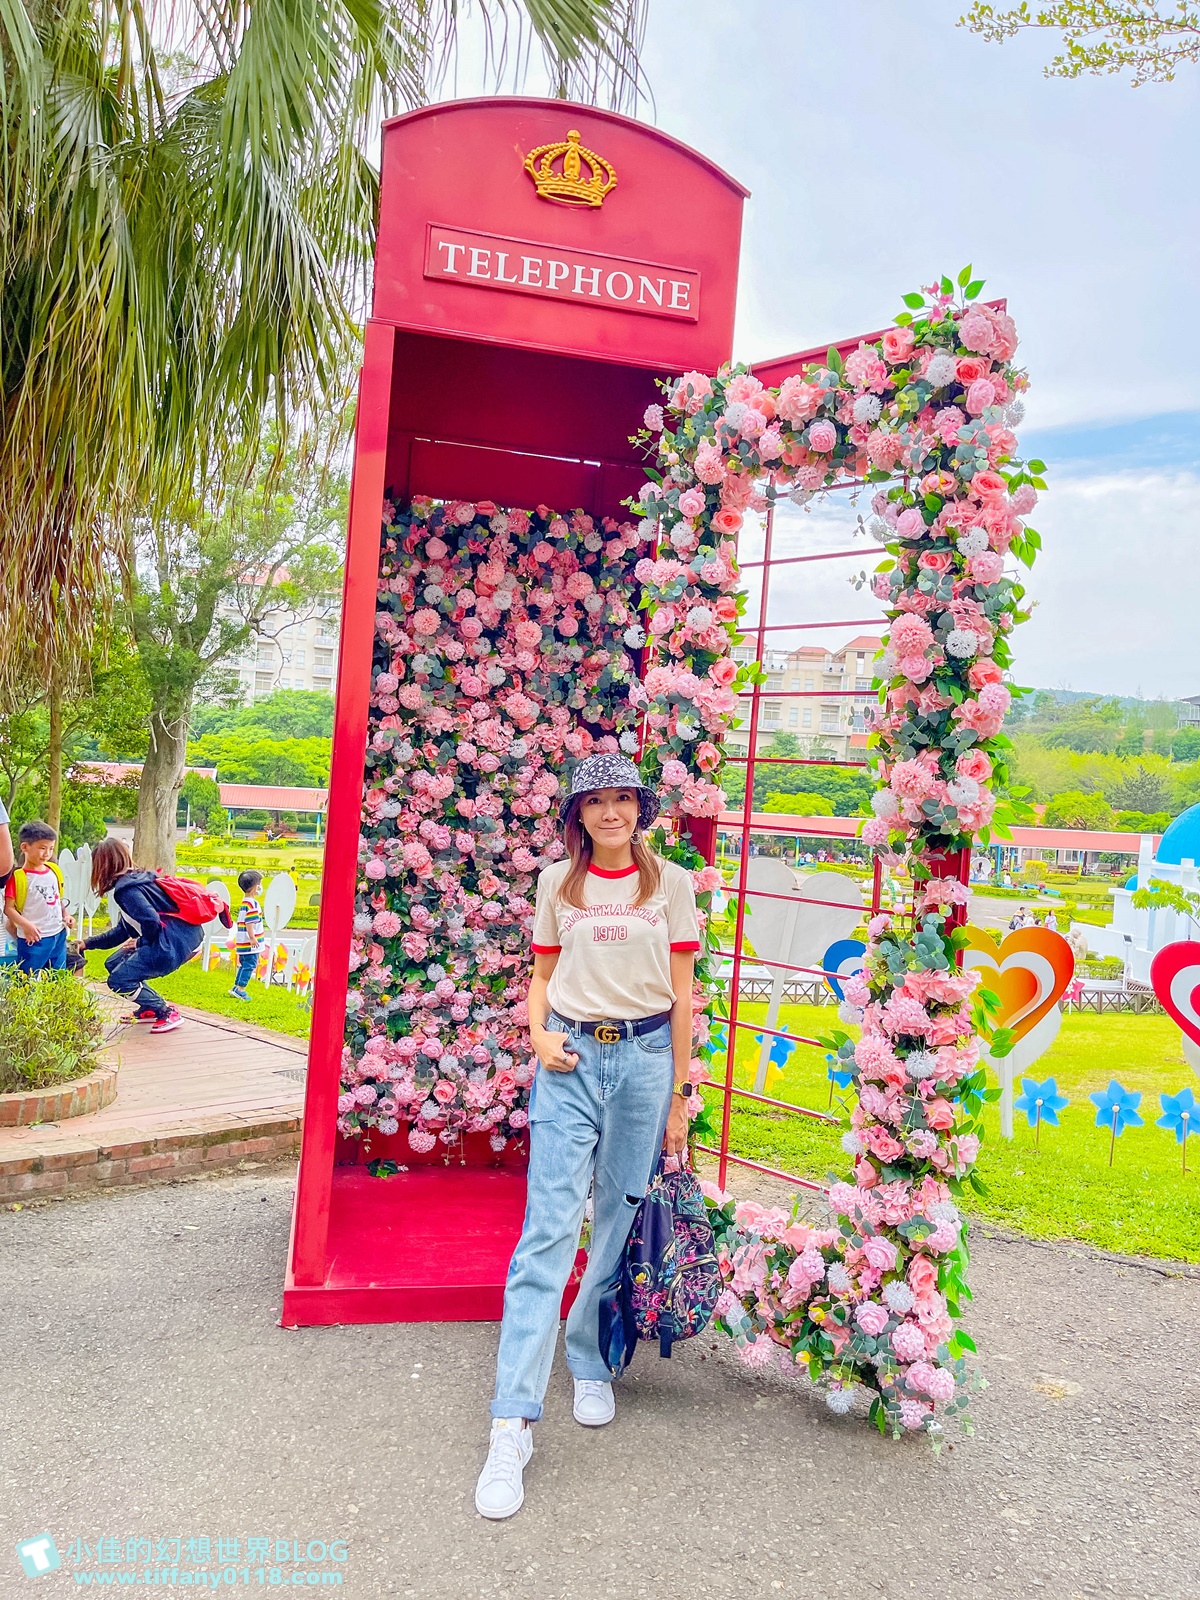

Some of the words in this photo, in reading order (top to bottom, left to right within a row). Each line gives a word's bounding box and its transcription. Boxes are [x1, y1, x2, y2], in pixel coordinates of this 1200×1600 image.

[438, 240, 691, 311] TELEPHONE
[563, 903, 661, 932] MONTMARTRE
[593, 925, 628, 942] 1978
